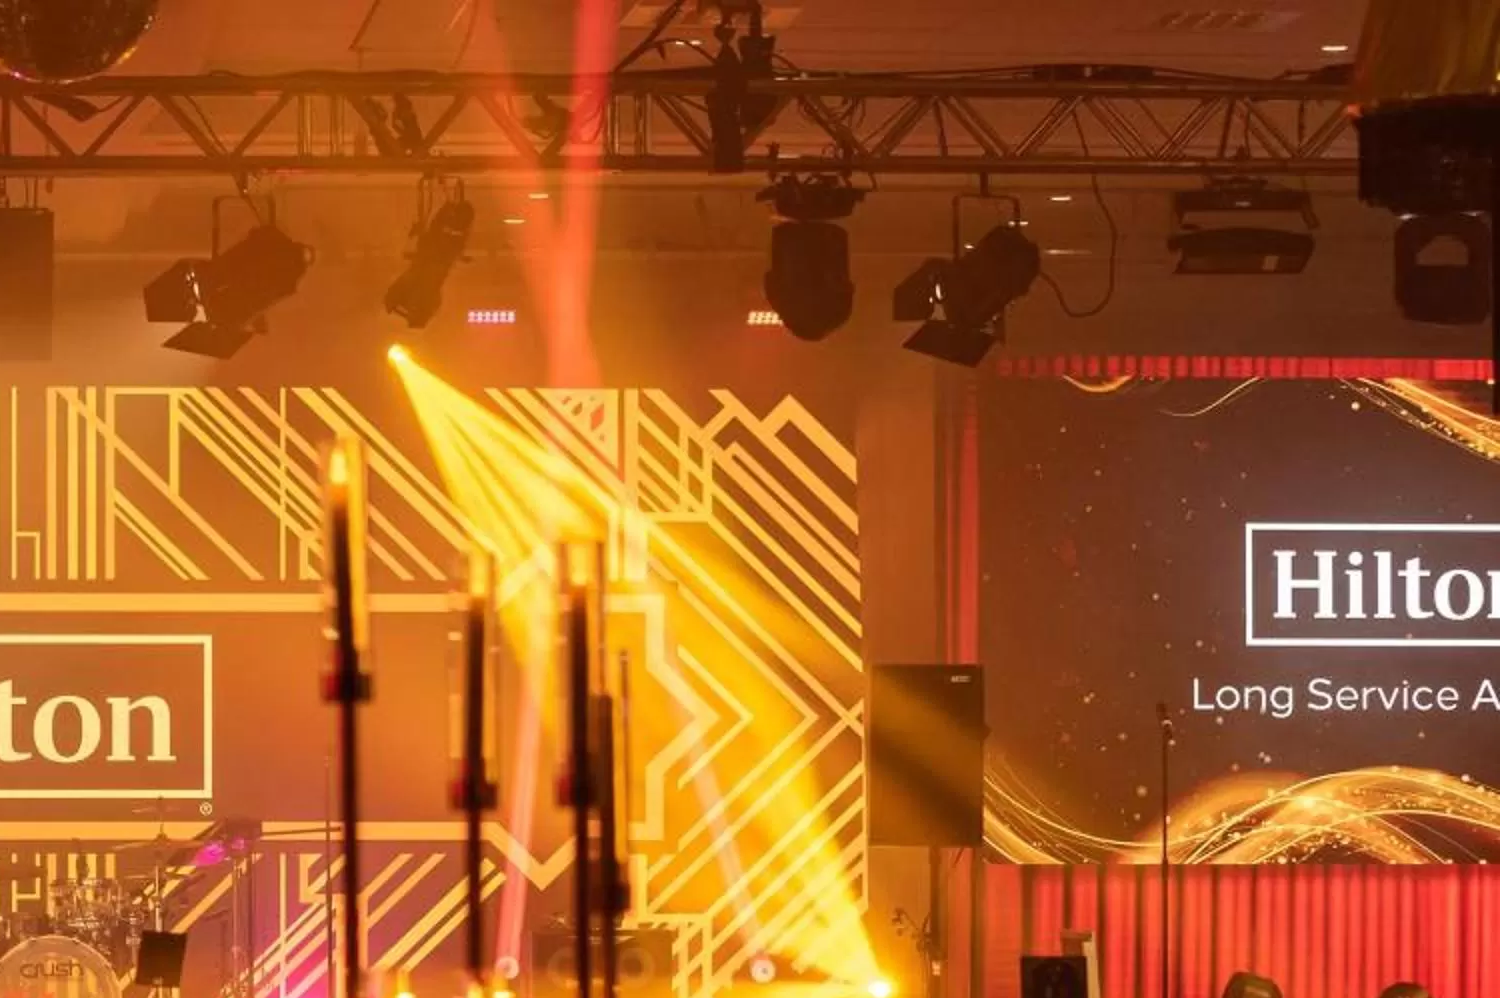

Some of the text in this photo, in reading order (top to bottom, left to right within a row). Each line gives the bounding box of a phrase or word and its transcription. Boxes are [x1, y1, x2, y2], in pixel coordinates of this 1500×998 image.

[1272, 550, 1500, 621] Hilto
[1193, 677, 1293, 718] Long
[1308, 678, 1459, 711] Service
